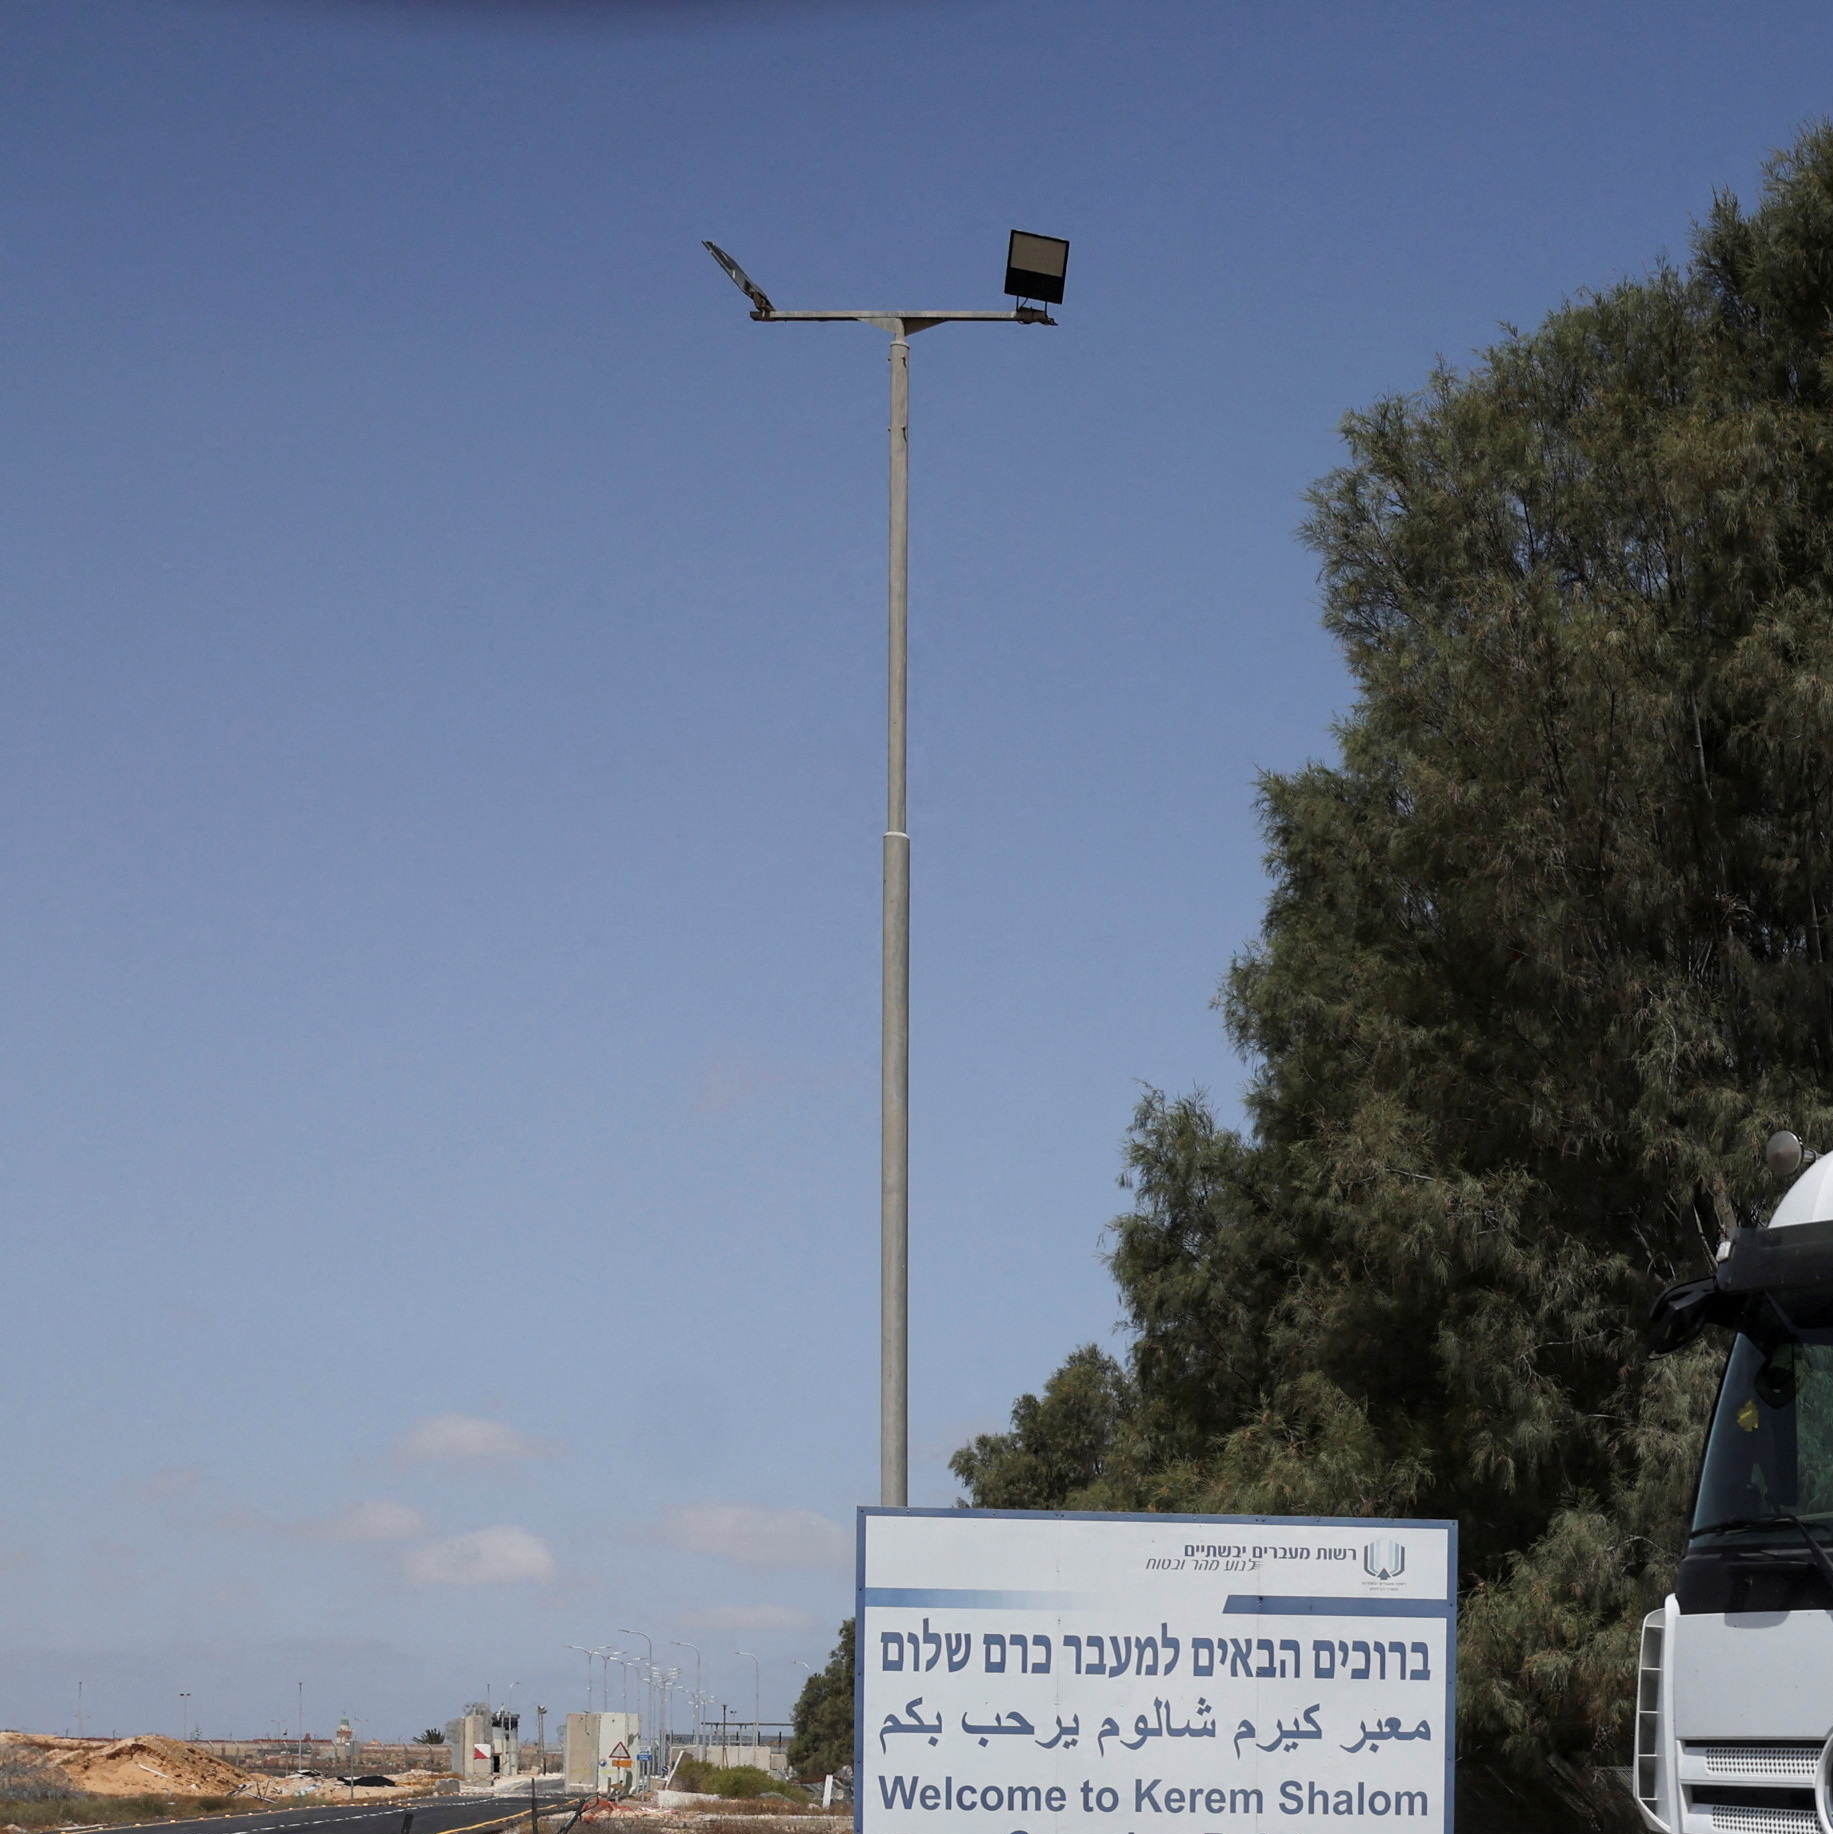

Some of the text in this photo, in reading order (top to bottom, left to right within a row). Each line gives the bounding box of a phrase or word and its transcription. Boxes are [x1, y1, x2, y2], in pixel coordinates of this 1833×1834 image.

[1145, 1558, 1263, 1572] לנוע מהר ובטוח
[1184, 1544, 1357, 1560] רשות מעברים יבשתיים
[880, 1617, 1431, 1681] ברוכים הבאים למעבר כרם שלום
[879, 1696, 1432, 1759] معبر كيرم شالوم يرحب بكم
[877, 1775, 1429, 1817] Welcome to Kerem Shalom
